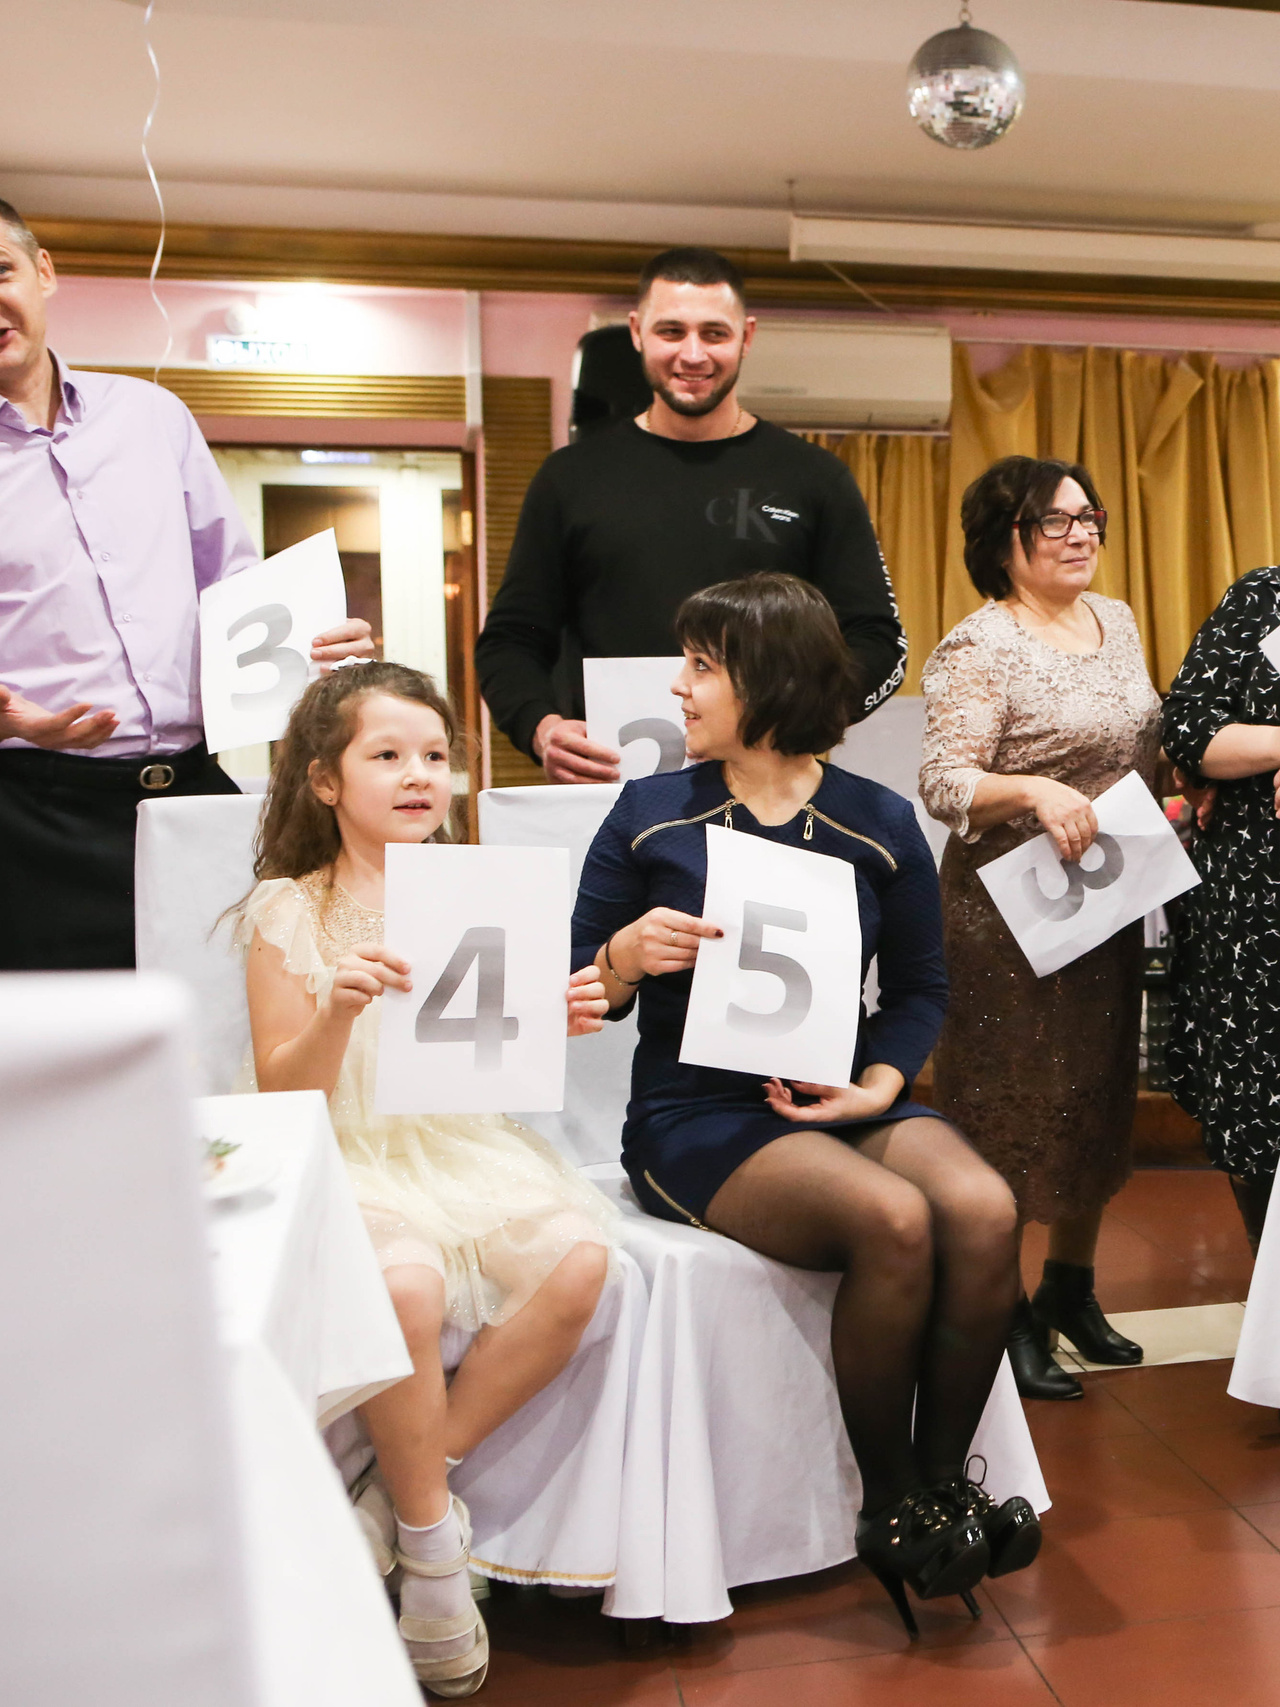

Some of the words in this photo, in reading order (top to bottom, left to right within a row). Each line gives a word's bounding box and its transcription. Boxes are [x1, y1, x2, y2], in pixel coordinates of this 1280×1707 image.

[705, 488, 782, 546] CK
[227, 603, 309, 711] 3
[618, 717, 687, 775] 2
[1021, 831, 1125, 922] 3
[415, 926, 519, 1072] 4
[726, 900, 813, 1038] 5
